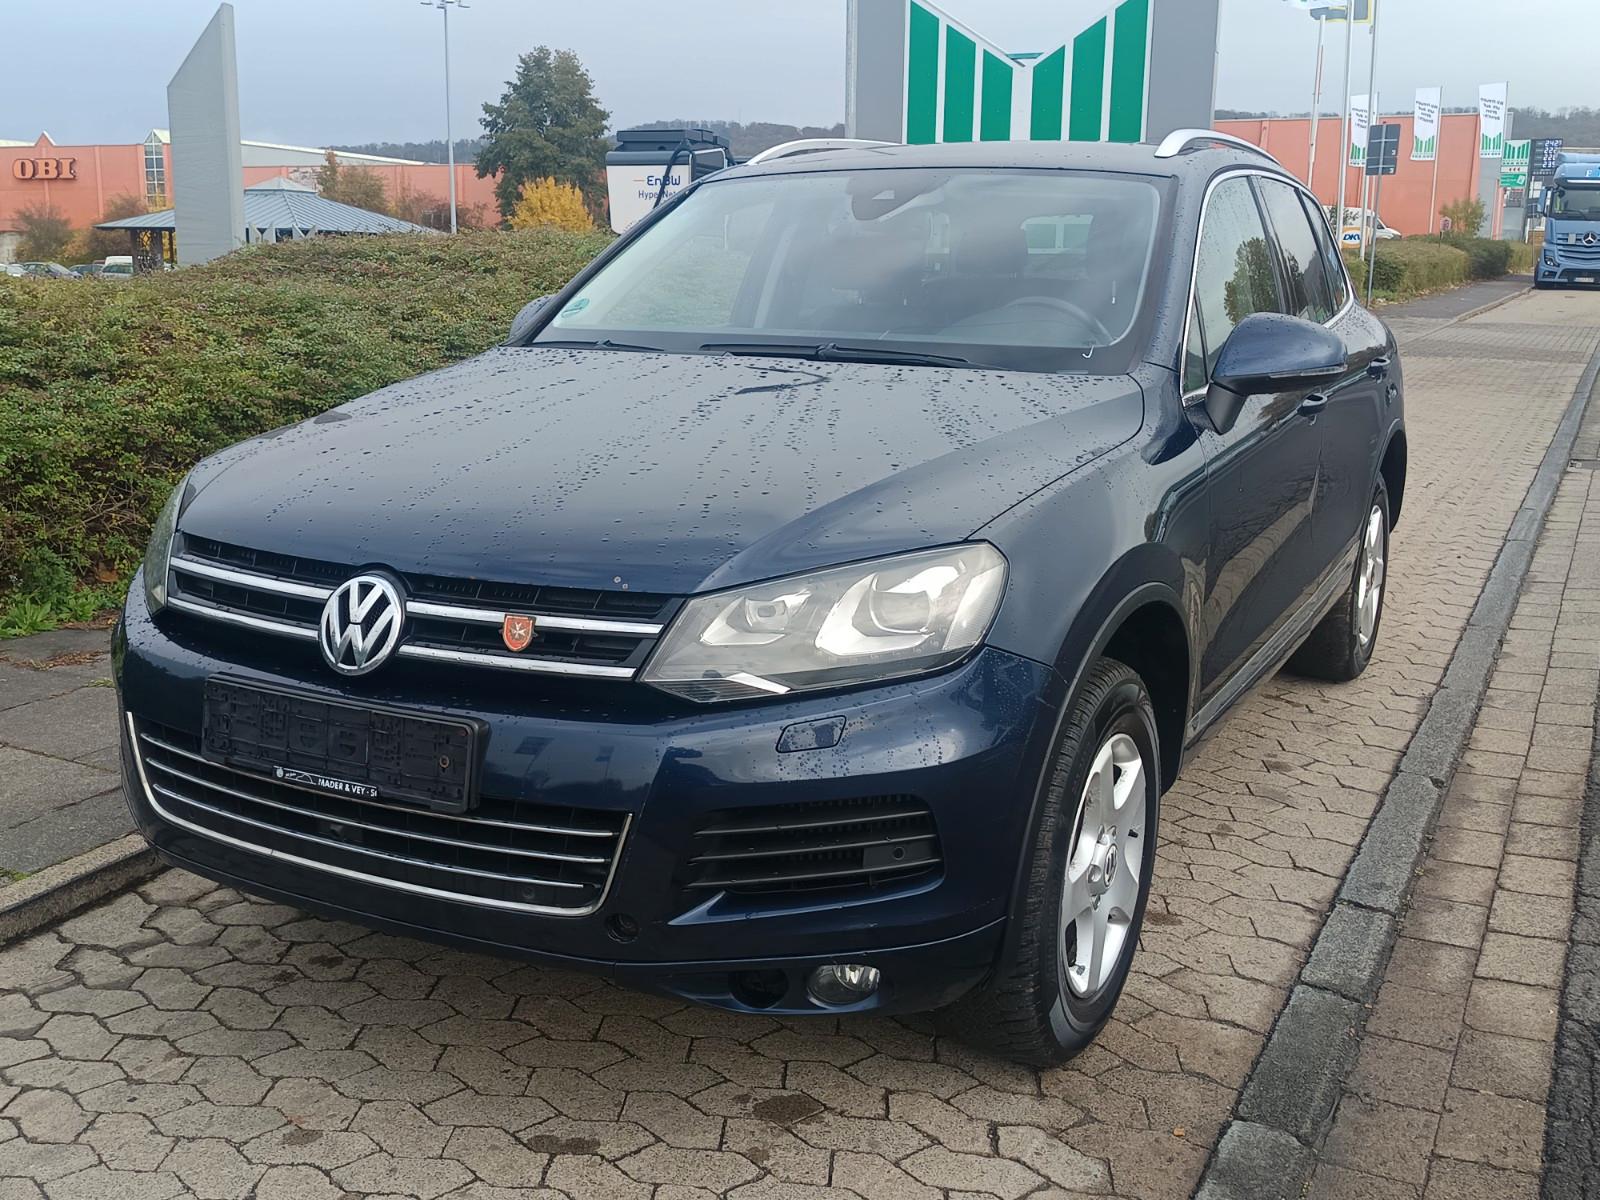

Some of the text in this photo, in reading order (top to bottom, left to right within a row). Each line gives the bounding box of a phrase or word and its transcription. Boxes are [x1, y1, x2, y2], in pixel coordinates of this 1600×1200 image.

[12, 158, 77, 180] OBI
[318, 778, 344, 791] MADER
[344, 783, 350, 792] &
[351, 784, 366, 796] VEY
